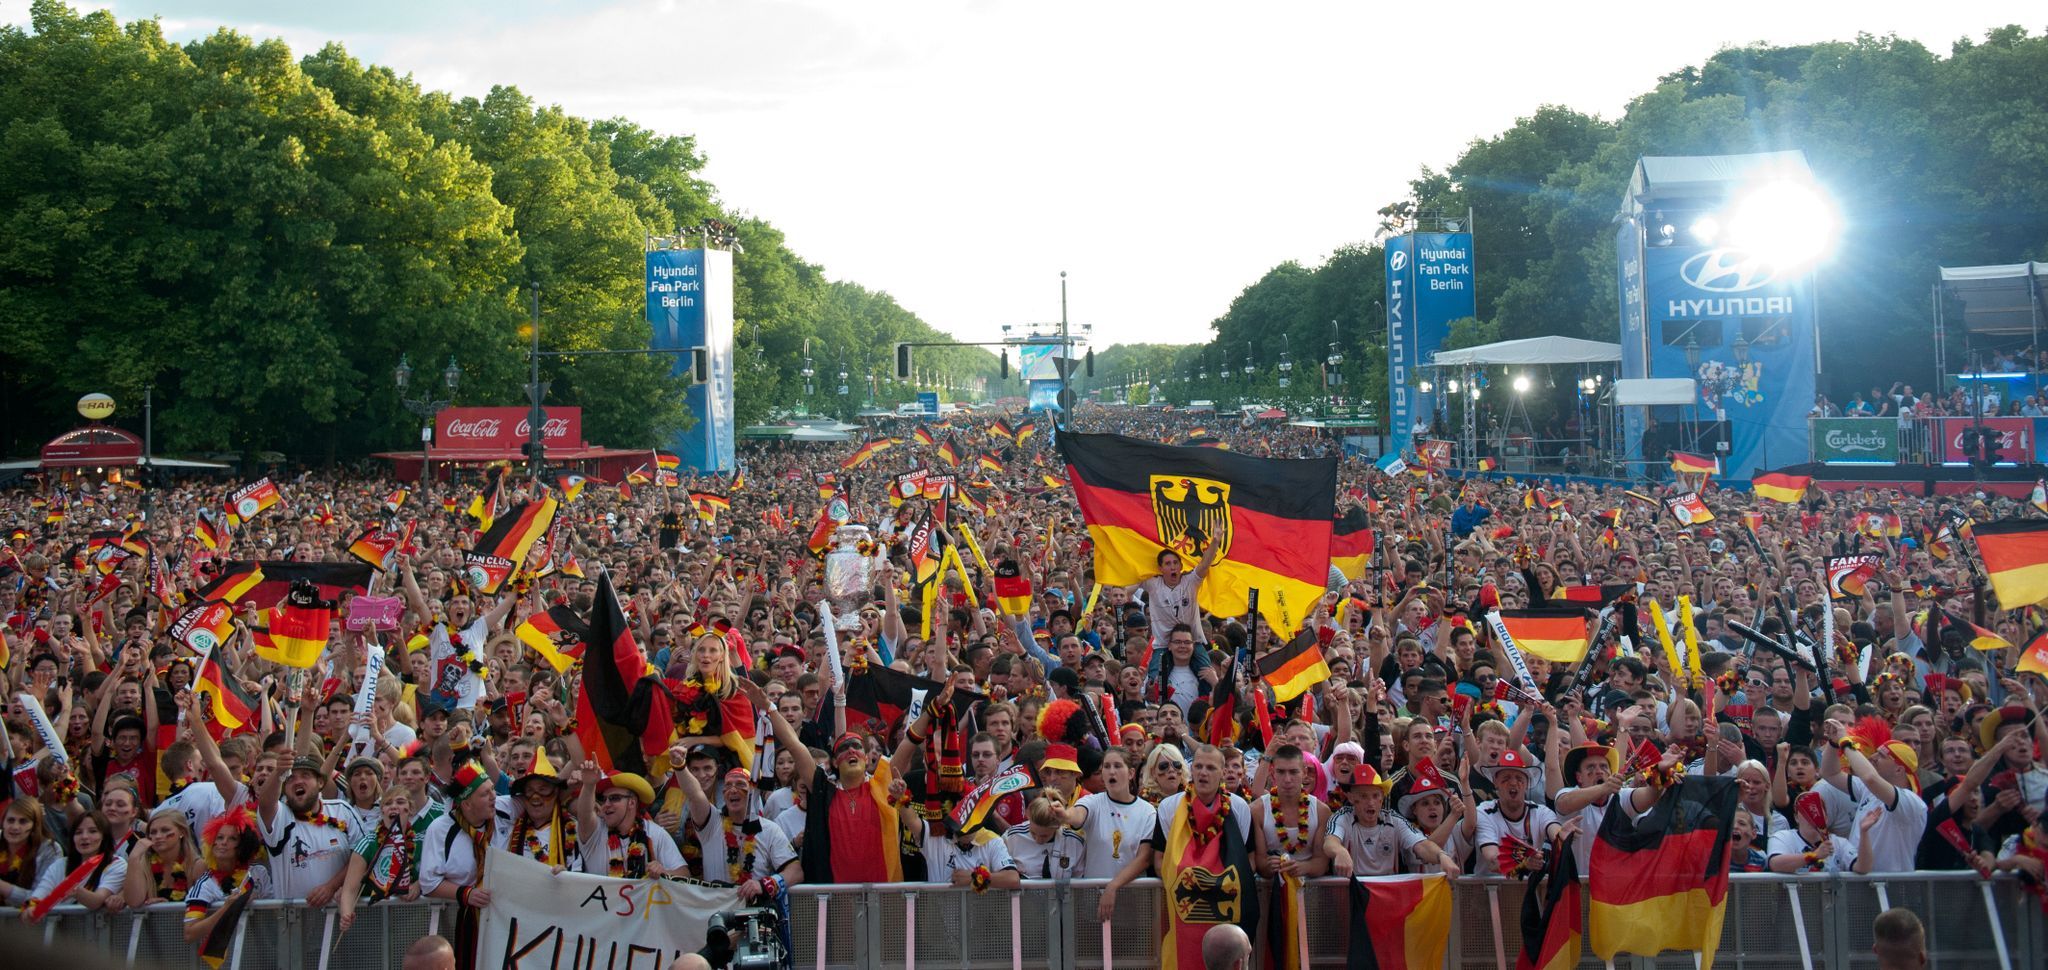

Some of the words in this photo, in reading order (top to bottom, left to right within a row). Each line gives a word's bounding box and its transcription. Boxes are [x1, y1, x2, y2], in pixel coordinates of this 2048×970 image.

[1421, 248, 1466, 261] Hyundai
[653, 265, 698, 279] Hyundai
[1420, 263, 1441, 275] Fan
[1444, 262, 1469, 275] Park
[651, 281, 673, 293] Fan
[674, 280, 700, 292] Park
[1430, 279, 1464, 291] Berlin
[661, 296, 694, 308] Berlin
[1669, 296, 1793, 317] HYUNDAI
[1391, 280, 1407, 416] HYUNDAI
[1825, 429, 1887, 453] Carlsberg
[232, 487, 247, 502] FAN
[247, 476, 269, 491] CLUB
[466, 553, 485, 564] FAN
[1830, 555, 1859, 567] FAN
[171, 617, 190, 639] FAN
[1495, 621, 1525, 671] HYUNDAI
